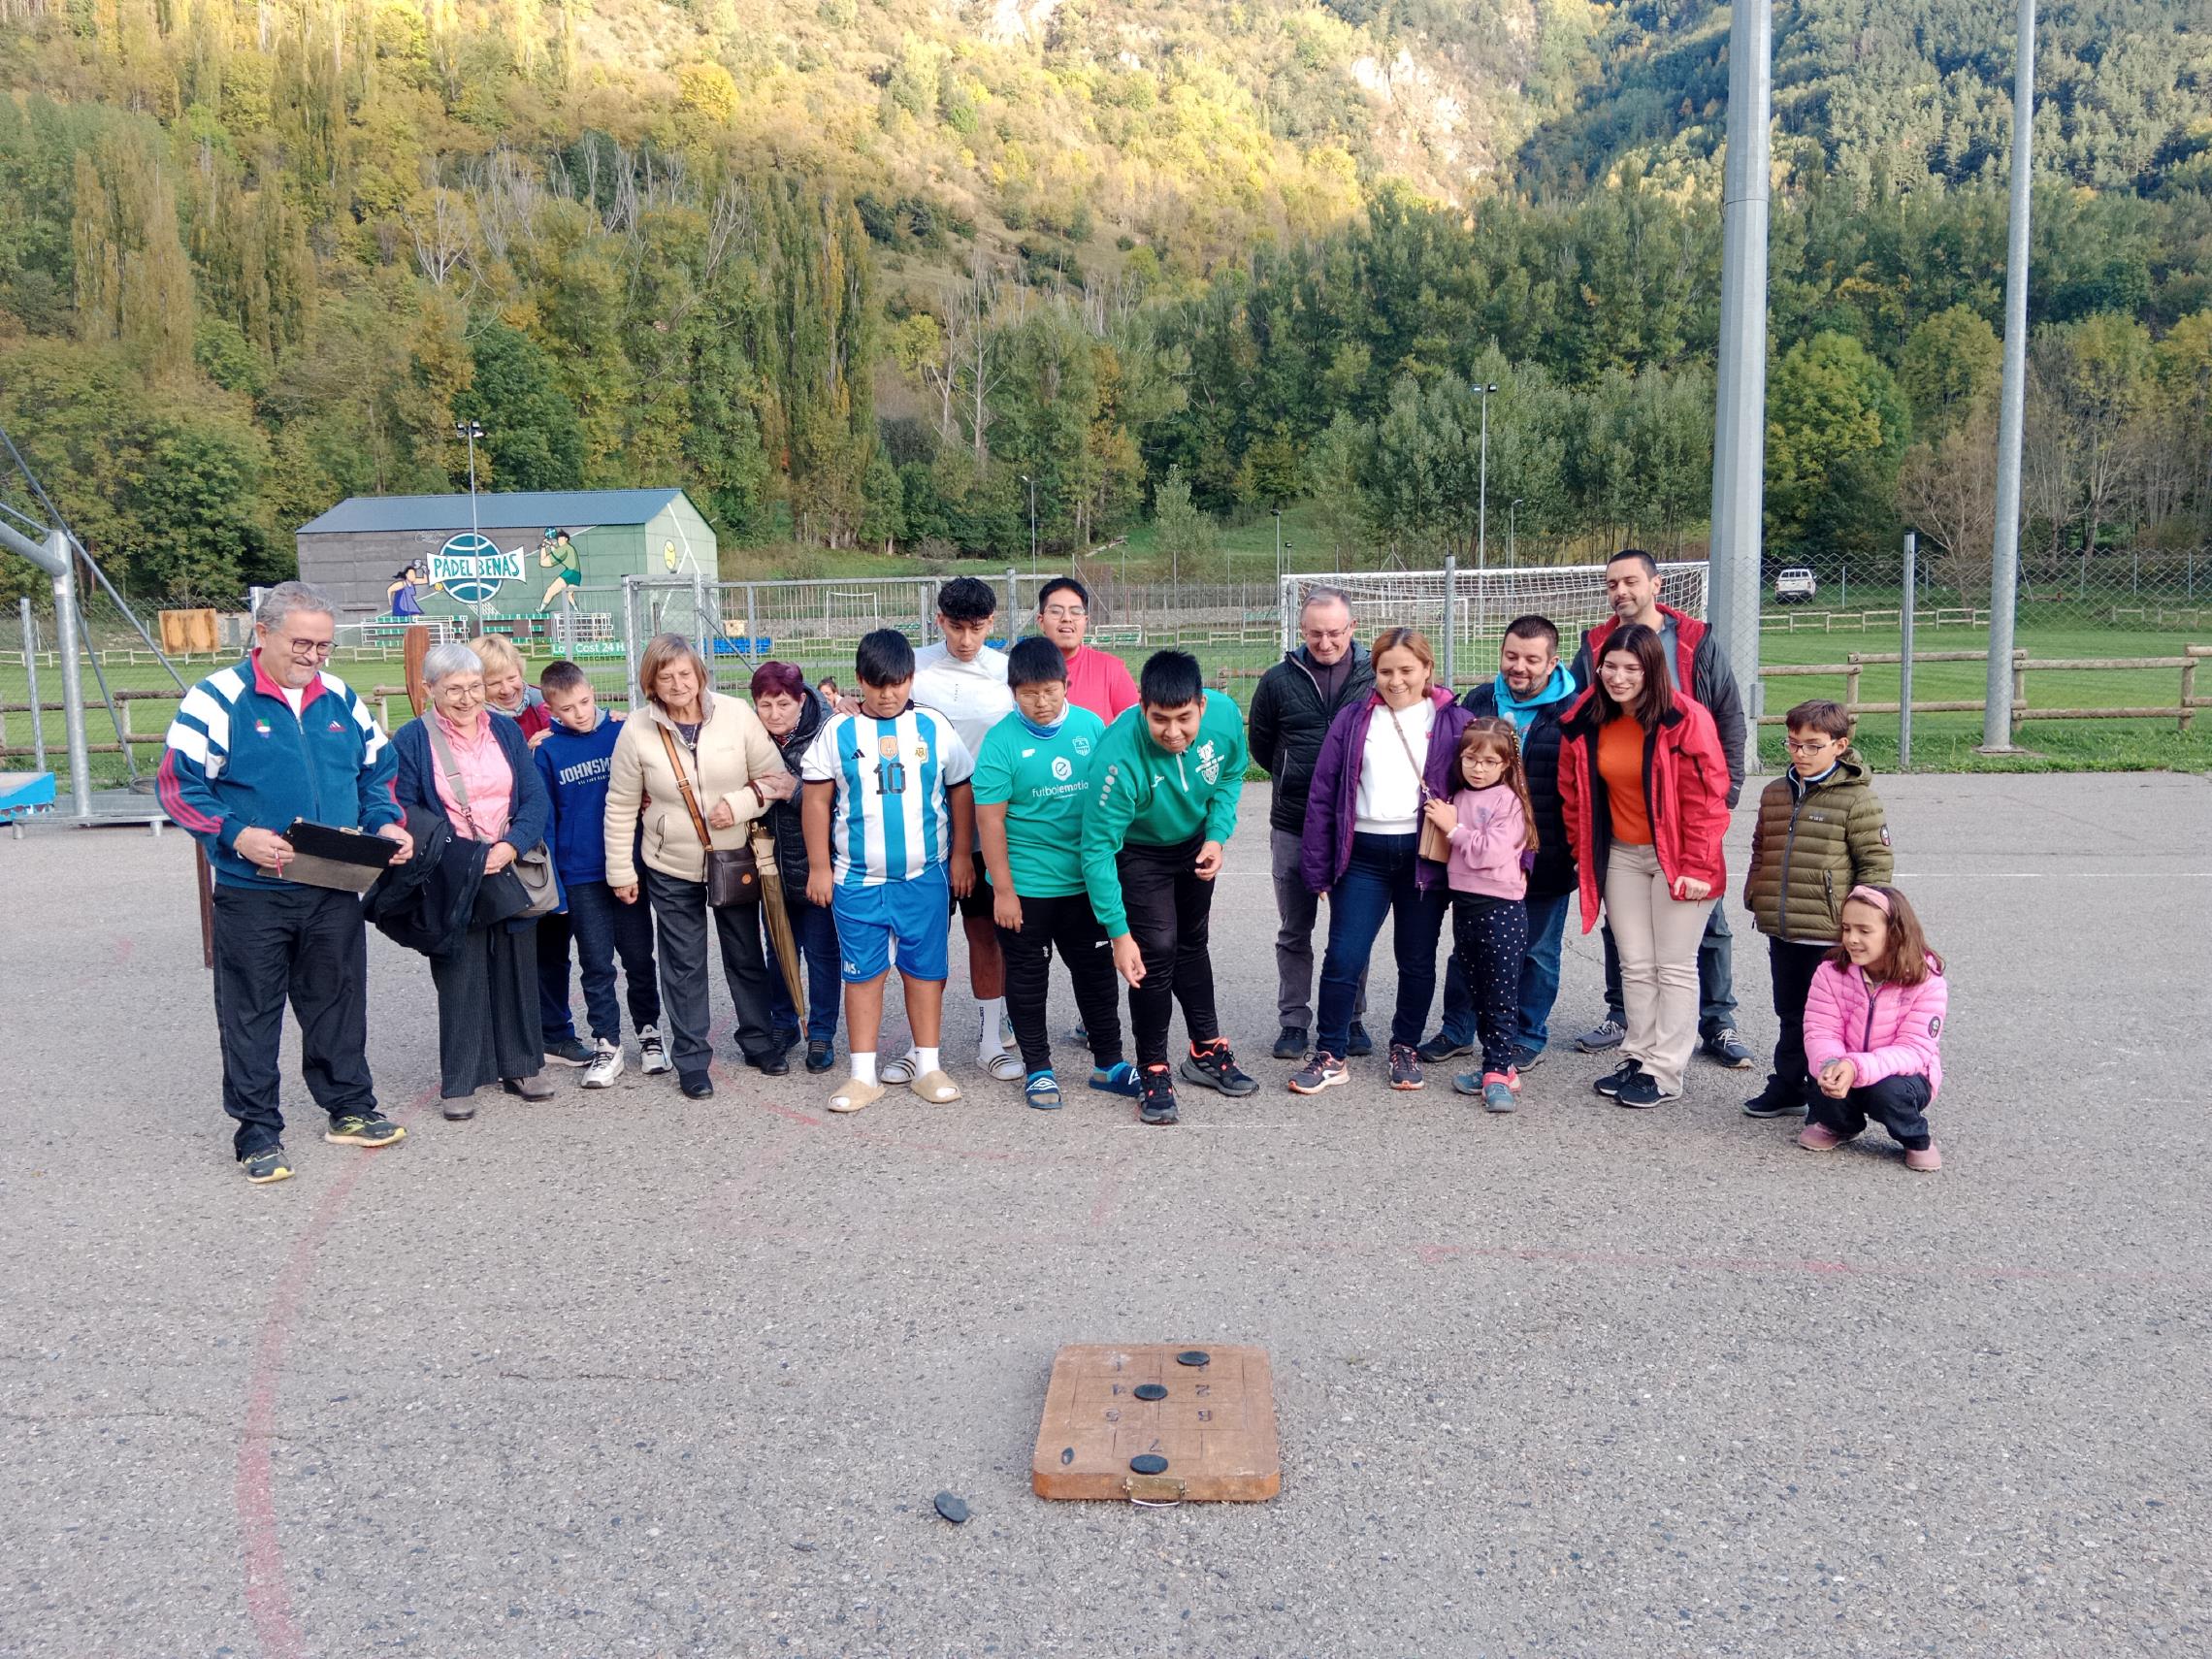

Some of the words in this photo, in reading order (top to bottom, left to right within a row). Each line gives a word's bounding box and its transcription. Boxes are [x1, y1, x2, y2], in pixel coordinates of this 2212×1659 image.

[477, 553, 520, 577] BENAS
[552, 643, 568, 653] Lo
[575, 643, 601, 653] Cost
[602, 642, 615, 653] 24
[559, 757, 611, 785] JOHNSM
[873, 762, 906, 795] 10
[1031, 780, 1090, 797] futbolemotio
[1194, 1383, 1211, 1397] 2
[1105, 1410, 1121, 1422] 5
[1148, 1438, 1163, 1453] 7
